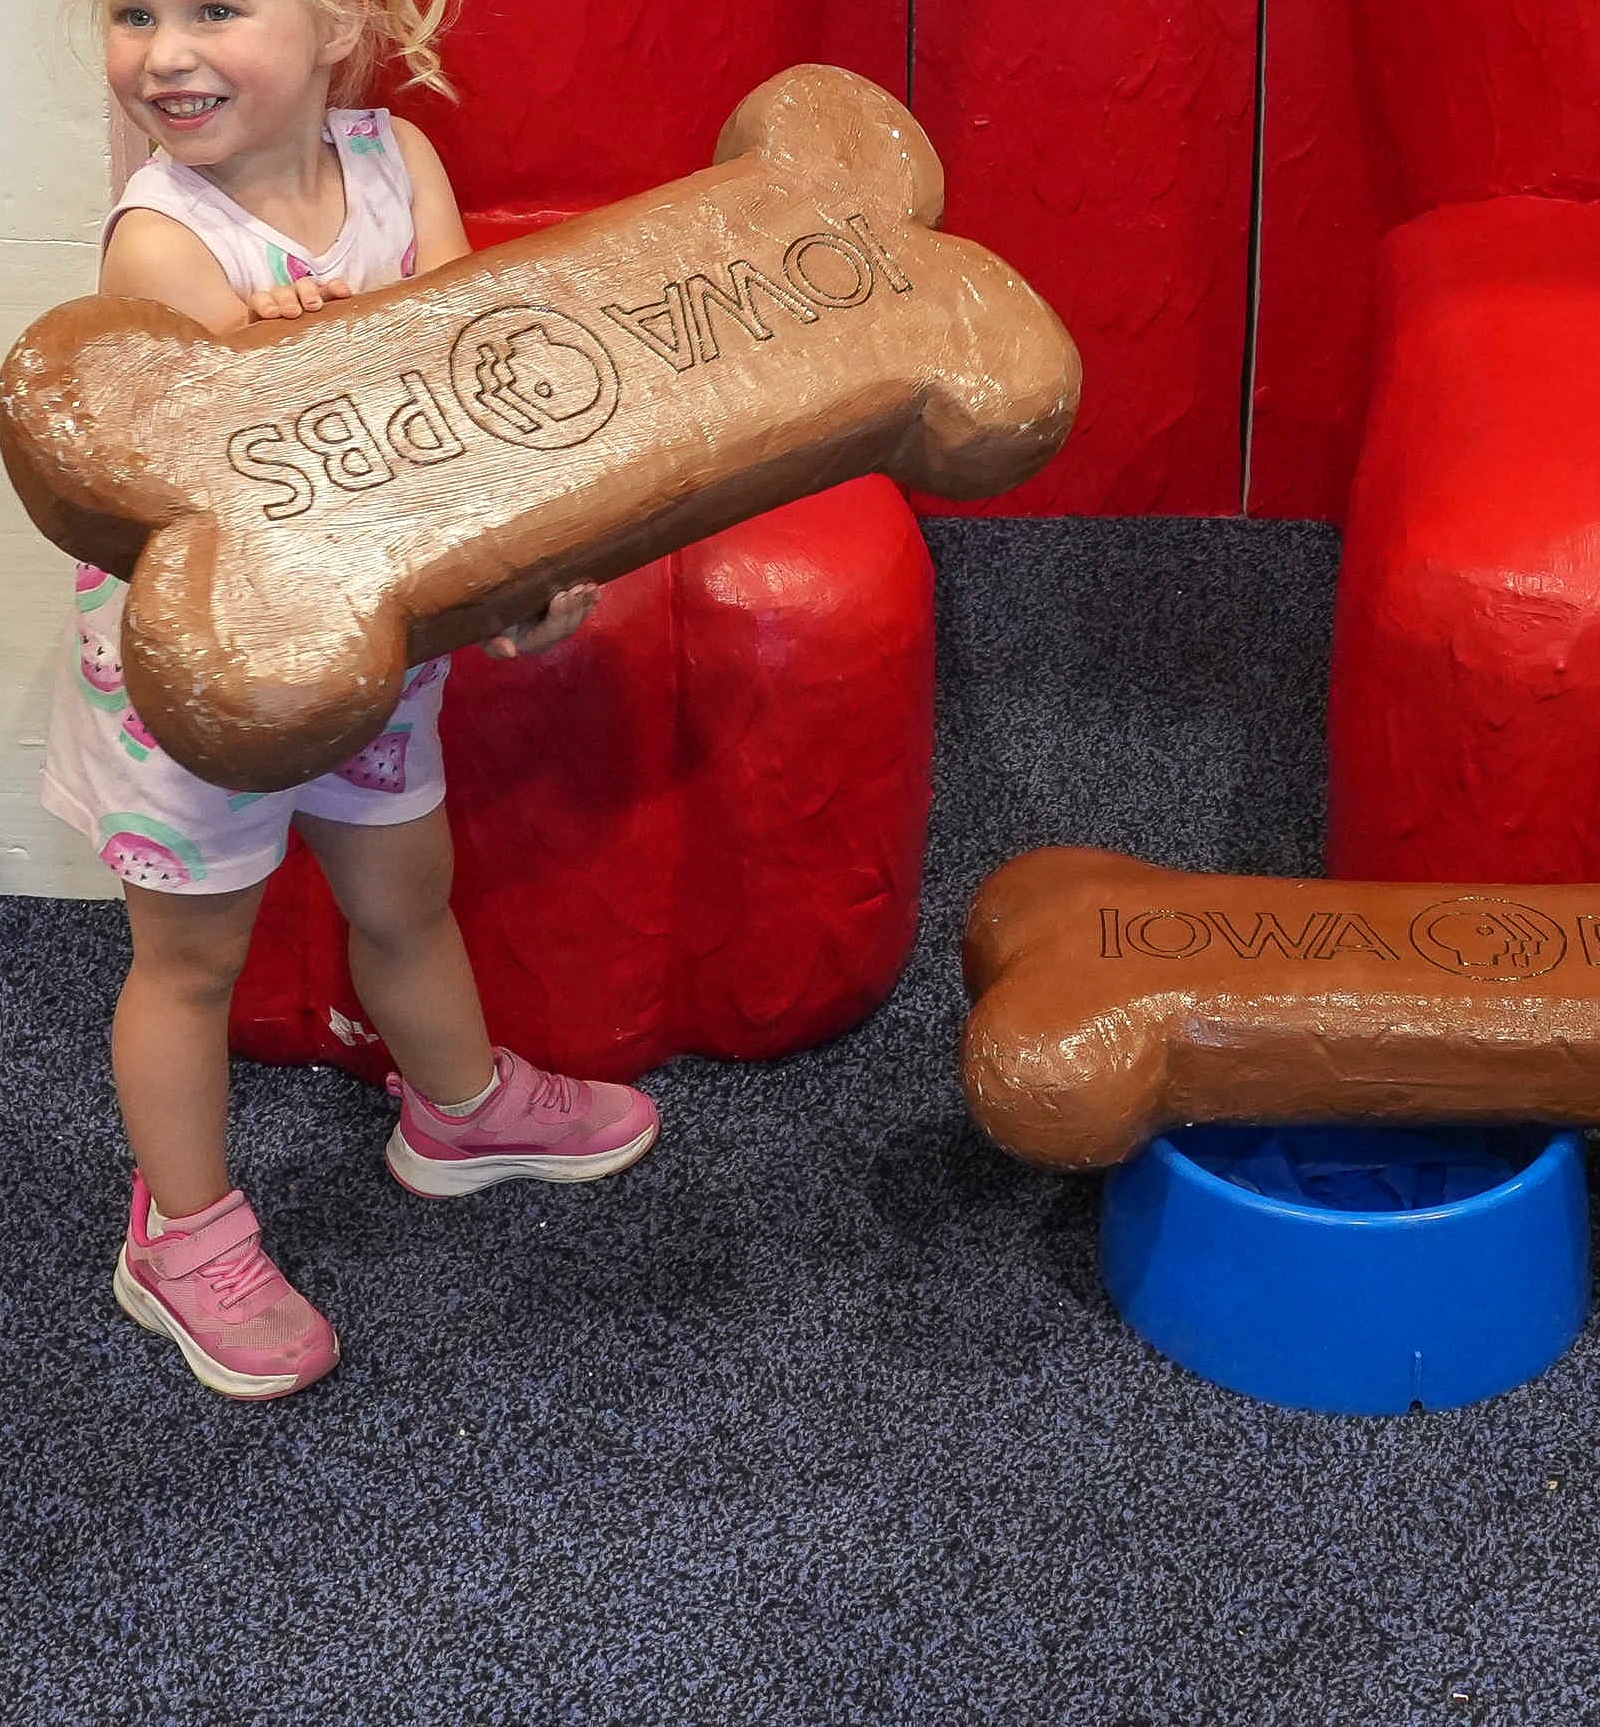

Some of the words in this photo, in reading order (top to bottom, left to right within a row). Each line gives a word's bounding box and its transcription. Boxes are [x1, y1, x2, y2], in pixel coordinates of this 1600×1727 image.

[605, 213, 914, 375] IOWA
[226, 369, 467, 522] PBS
[1099, 907, 1400, 962] IOWA
